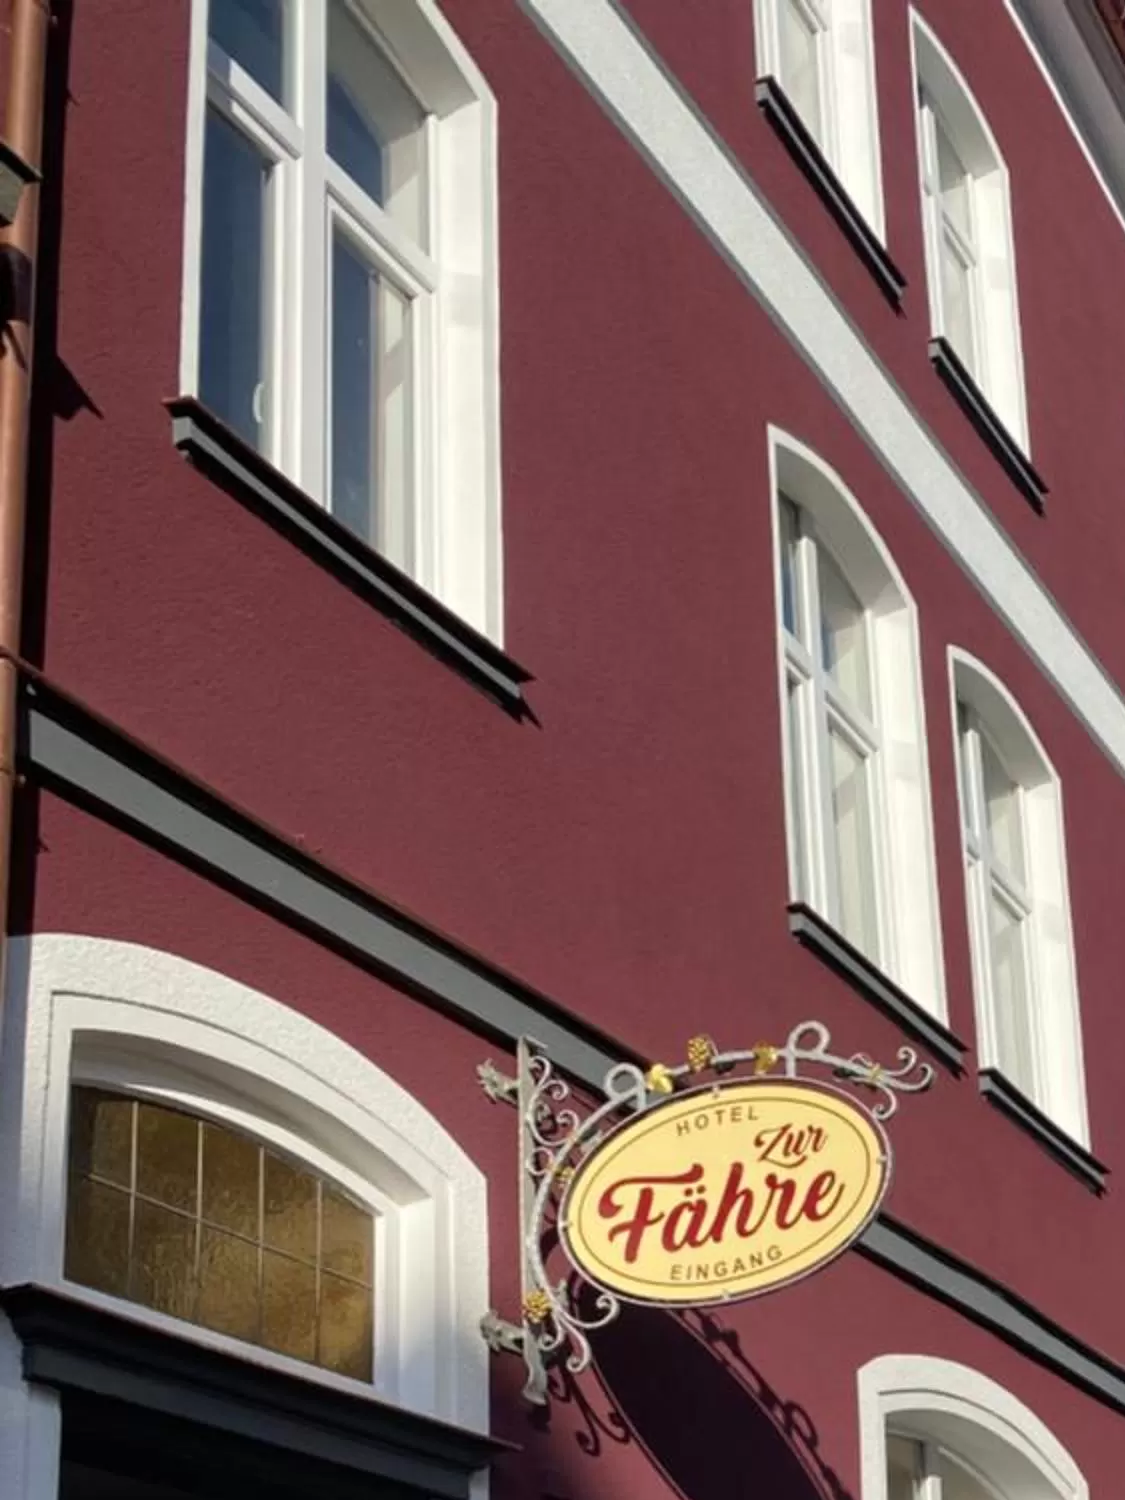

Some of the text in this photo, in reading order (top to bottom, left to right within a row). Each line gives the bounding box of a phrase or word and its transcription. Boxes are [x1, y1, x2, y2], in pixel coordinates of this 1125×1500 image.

[676, 1105, 759, 1137] HOTEL
[754, 1123, 828, 1168] Zur
[599, 1162, 845, 1263] Fähre
[670, 1244, 783, 1281] EINGANG
